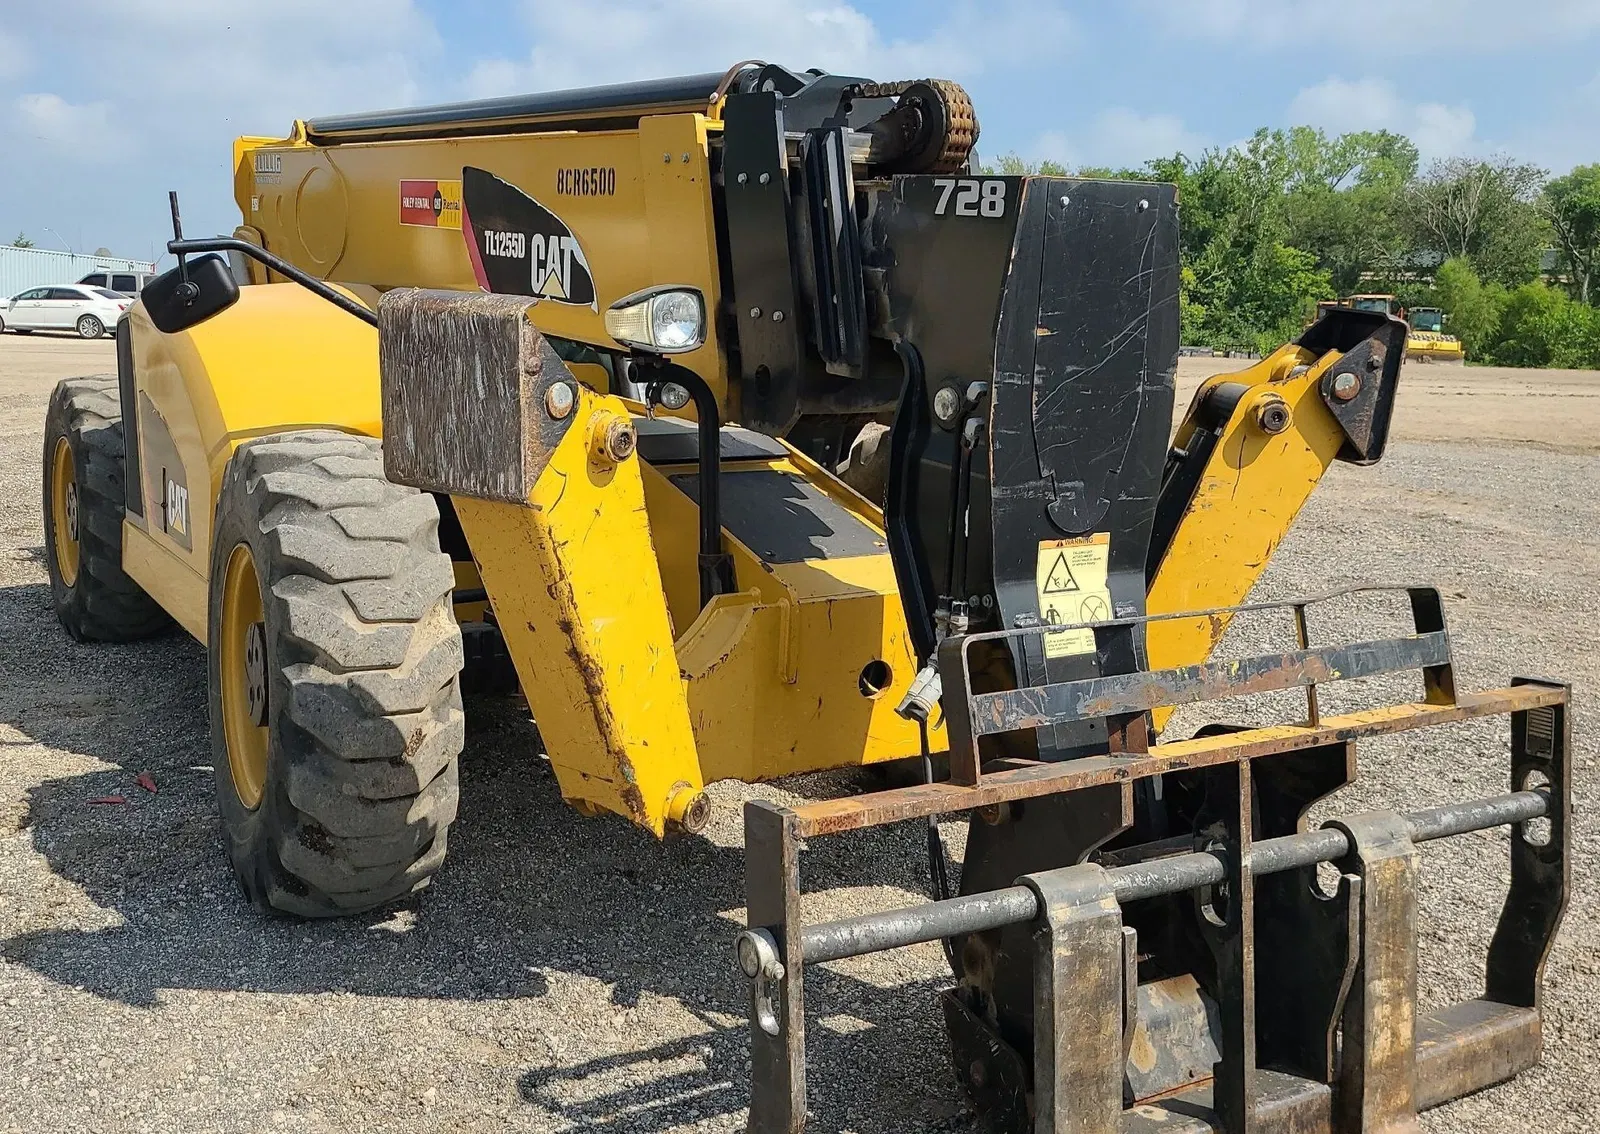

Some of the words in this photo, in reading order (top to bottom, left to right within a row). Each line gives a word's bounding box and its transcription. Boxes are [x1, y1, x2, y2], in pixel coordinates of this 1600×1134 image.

[557, 167, 616, 196] 8CR6500
[933, 178, 1006, 218] 728
[484, 230, 526, 259] TL1255D
[531, 233, 574, 299] CAT
[168, 479, 188, 536] CAT
